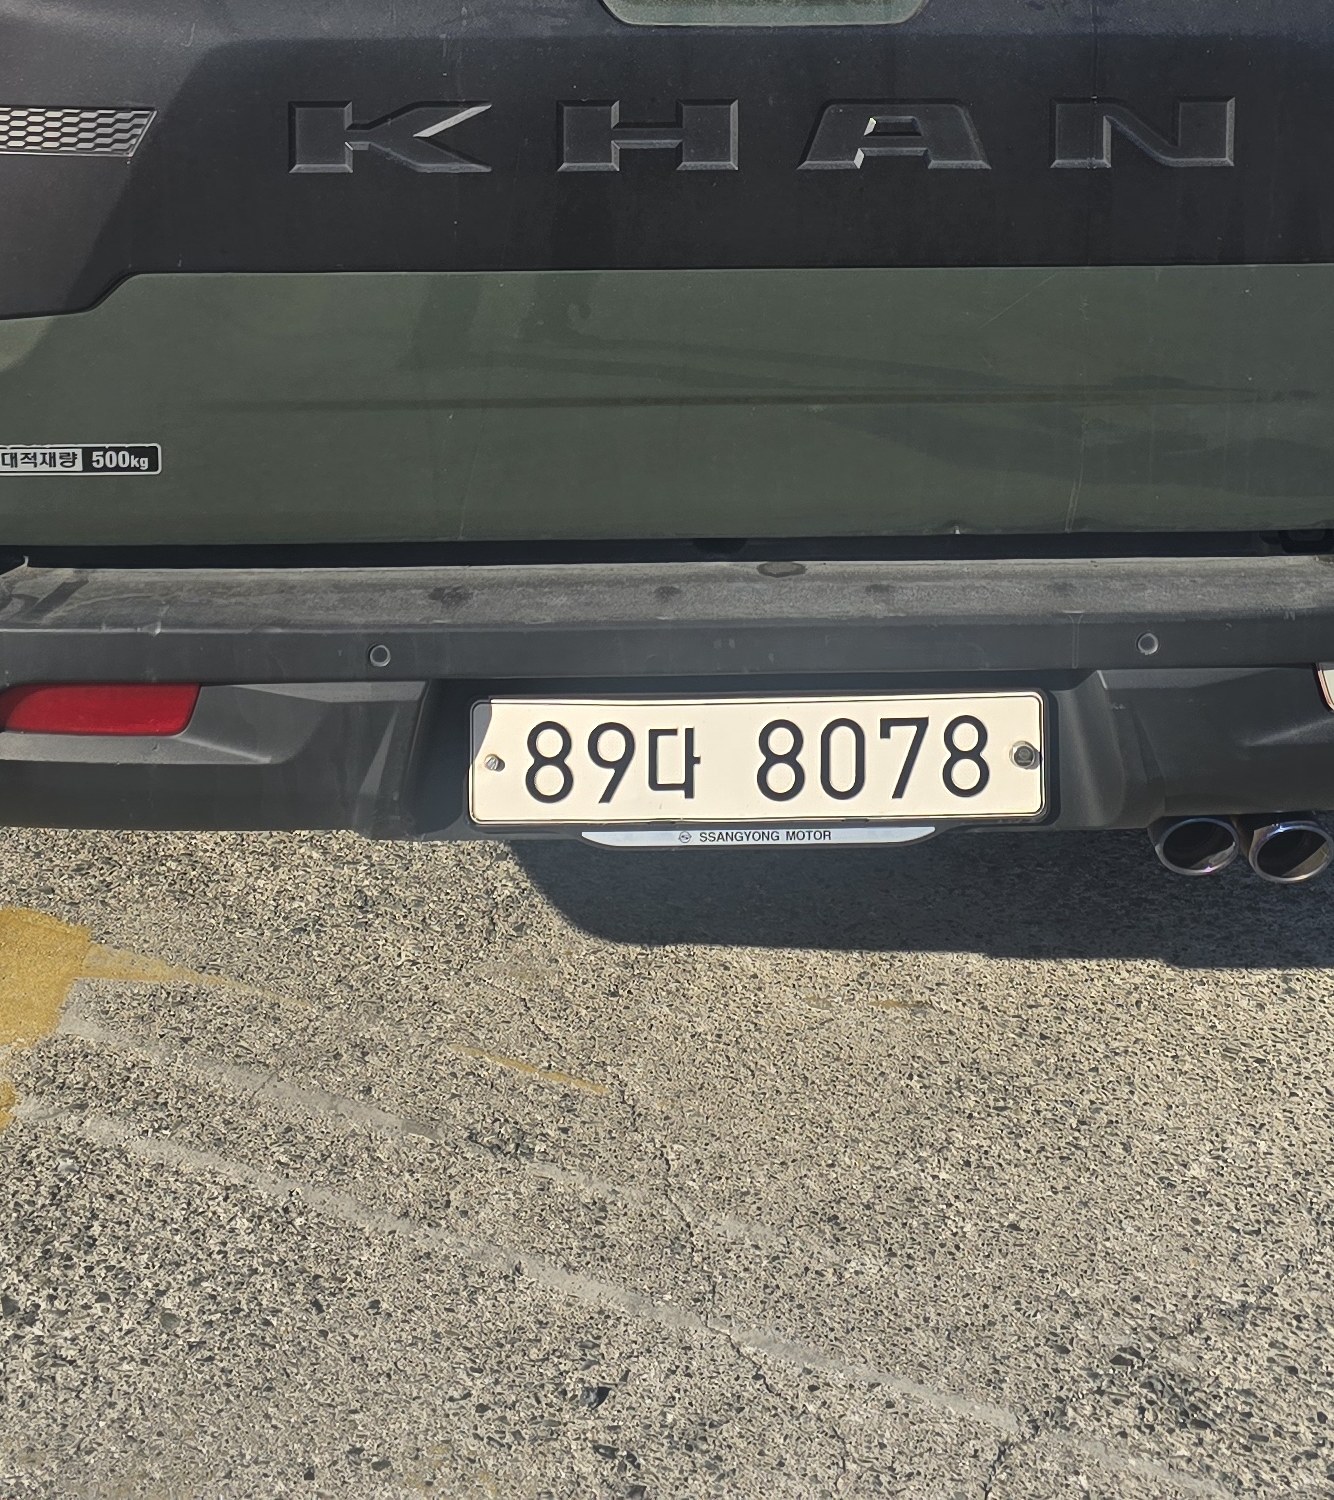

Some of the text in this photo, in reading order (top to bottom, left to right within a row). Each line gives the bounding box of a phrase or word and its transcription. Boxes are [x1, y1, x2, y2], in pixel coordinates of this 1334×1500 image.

[287, 96, 1237, 174] KHAN
[91, 450, 149, 470] 500kg
[524, 714, 991, 804] 89다 8078
[699, 830, 832, 843] SSANGYONG MOTOR
